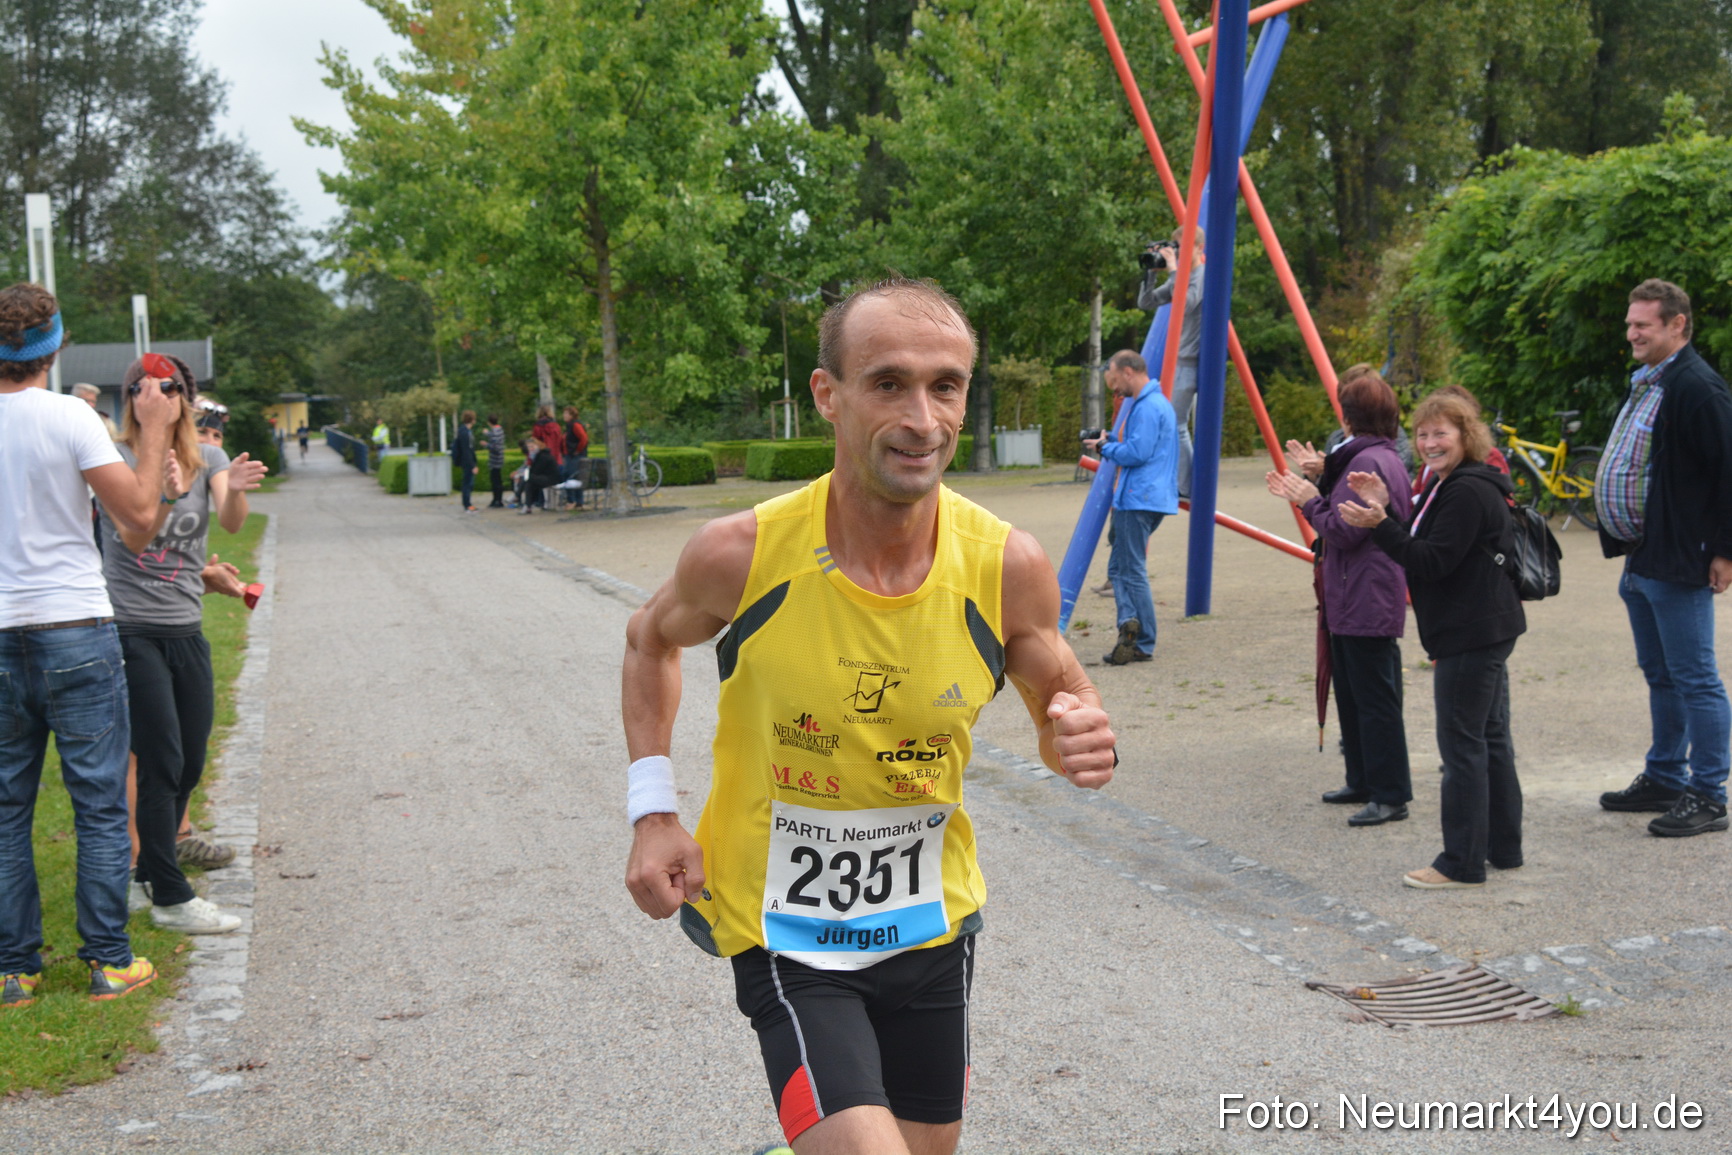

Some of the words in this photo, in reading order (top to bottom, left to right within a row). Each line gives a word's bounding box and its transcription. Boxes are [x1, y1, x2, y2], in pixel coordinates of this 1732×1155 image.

[838, 656, 910, 674] FONDSZENTRUM
[933, 698, 968, 707] adidas
[842, 715, 894, 725] NEUMARKT
[773, 722, 839, 749] NEUMARKTER
[779, 738, 834, 757] MINERALBRUNNEN
[771, 763, 792, 784] M
[798, 770, 817, 790] &
[826, 775, 840, 793] S
[885, 768, 941, 783] PIZZERIA
[894, 780, 934, 795] ELIO
[775, 816, 837, 842] PARTL
[842, 819, 922, 842] Neumarkt
[785, 838, 925, 912] 2351
[770, 898, 779, 910] A
[816, 924, 899, 950] Jürgen
